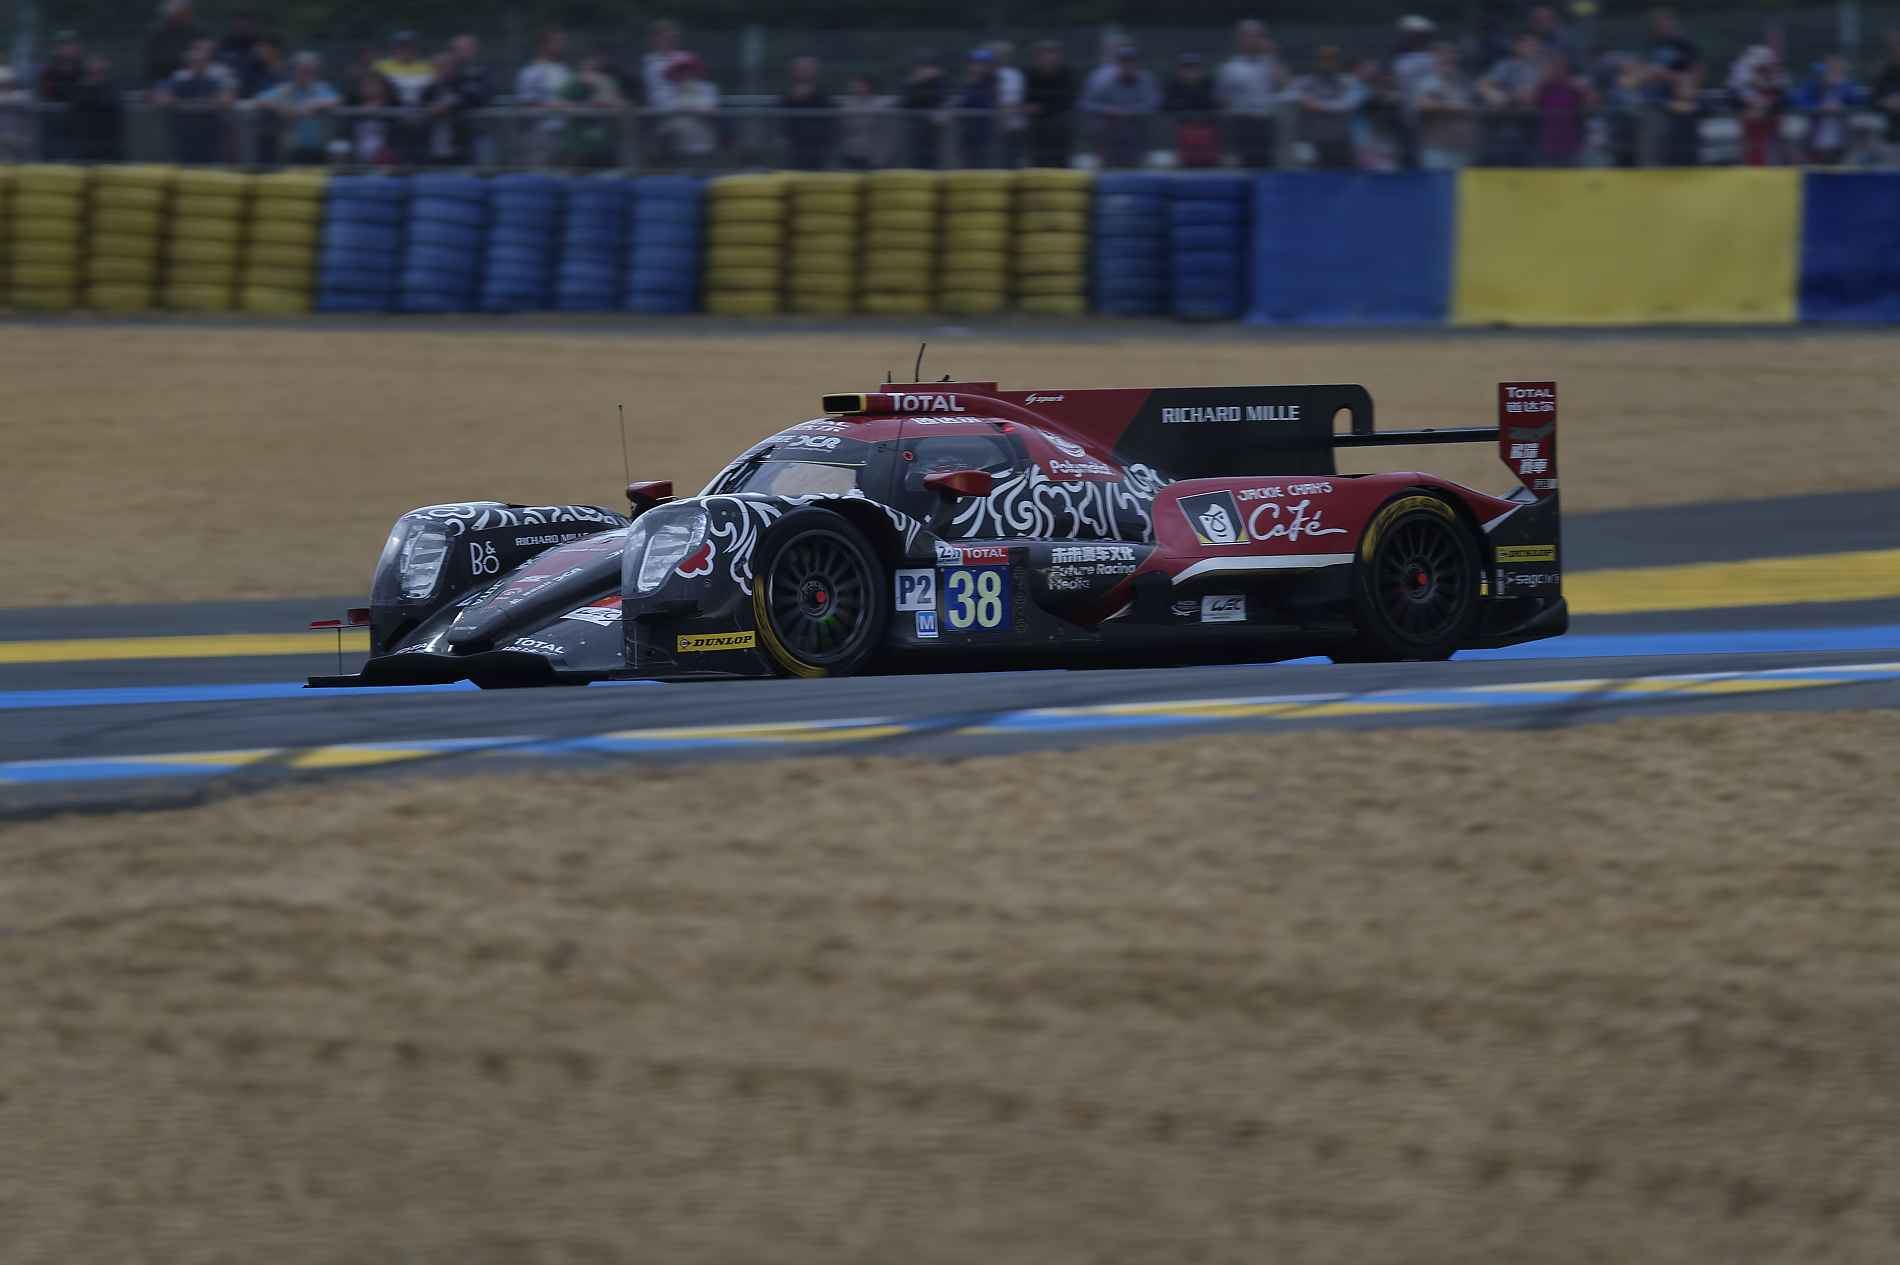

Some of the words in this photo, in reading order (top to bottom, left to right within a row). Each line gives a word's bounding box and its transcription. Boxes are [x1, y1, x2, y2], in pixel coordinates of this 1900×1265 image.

[1505, 387, 1555, 398] TOTAL
[887, 393, 966, 412] TOTAL
[1162, 406, 1241, 423] RICHARD
[1246, 405, 1300, 421] MILLE
[1237, 487, 1285, 501] JACKIE
[1248, 499, 1348, 541] Café
[515, 534, 559, 546] RICHARD
[963, 547, 1006, 559] TOTAL
[899, 575, 932, 604] P2
[948, 570, 1002, 628] 38
[919, 614, 936, 630] M
[514, 637, 566, 654] TOTAL
[692, 636, 752, 647] DUNLOP
